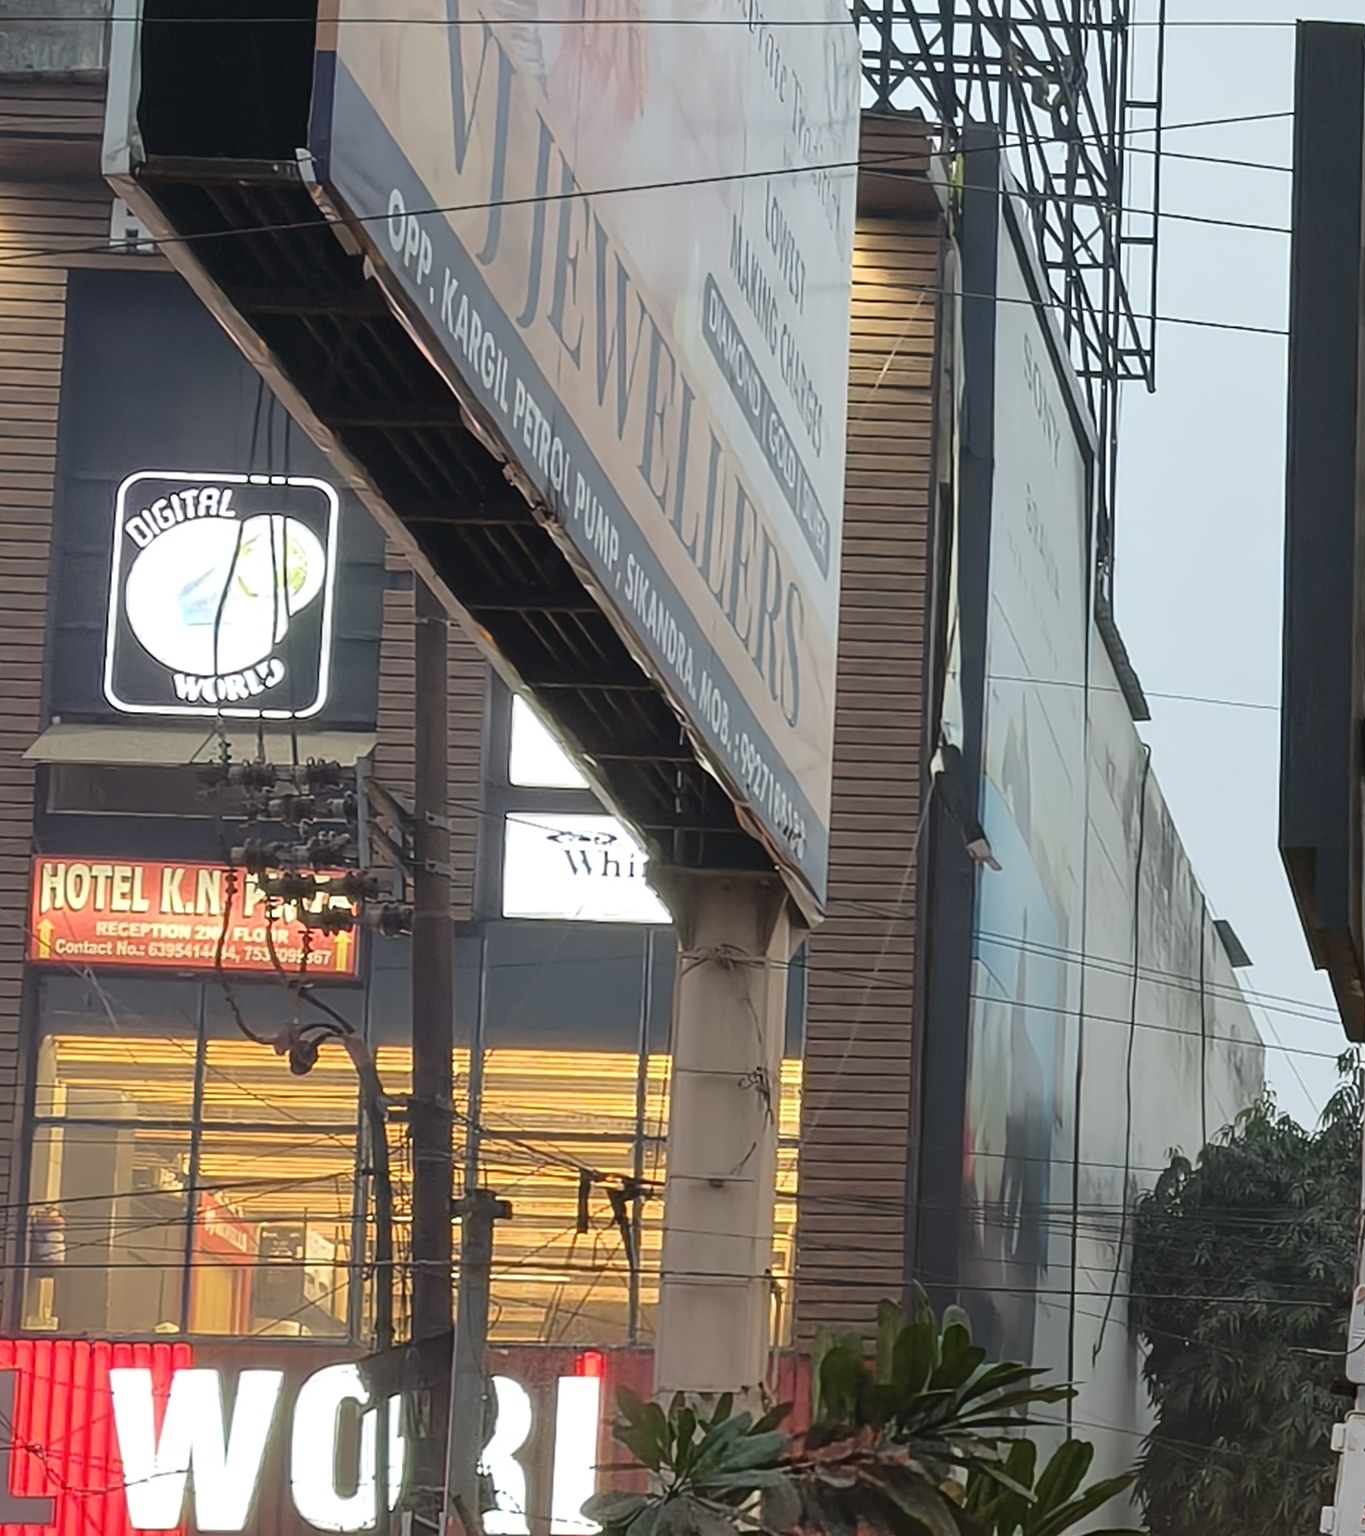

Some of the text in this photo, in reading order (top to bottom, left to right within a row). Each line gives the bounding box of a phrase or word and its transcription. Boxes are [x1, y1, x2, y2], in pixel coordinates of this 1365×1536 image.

[707, 287, 762, 418] DIAMOND
[440, 266, 509, 414] KARGIL
[513, 377, 571, 507] PETROL
[516, 108, 806, 728] JEWELLERS
[125, 487, 236, 550] DIGITAL
[41, 863, 151, 913] HOTEL
[55, 938, 119, 956] Contact
[96, 921, 192, 942] RECEPTION
